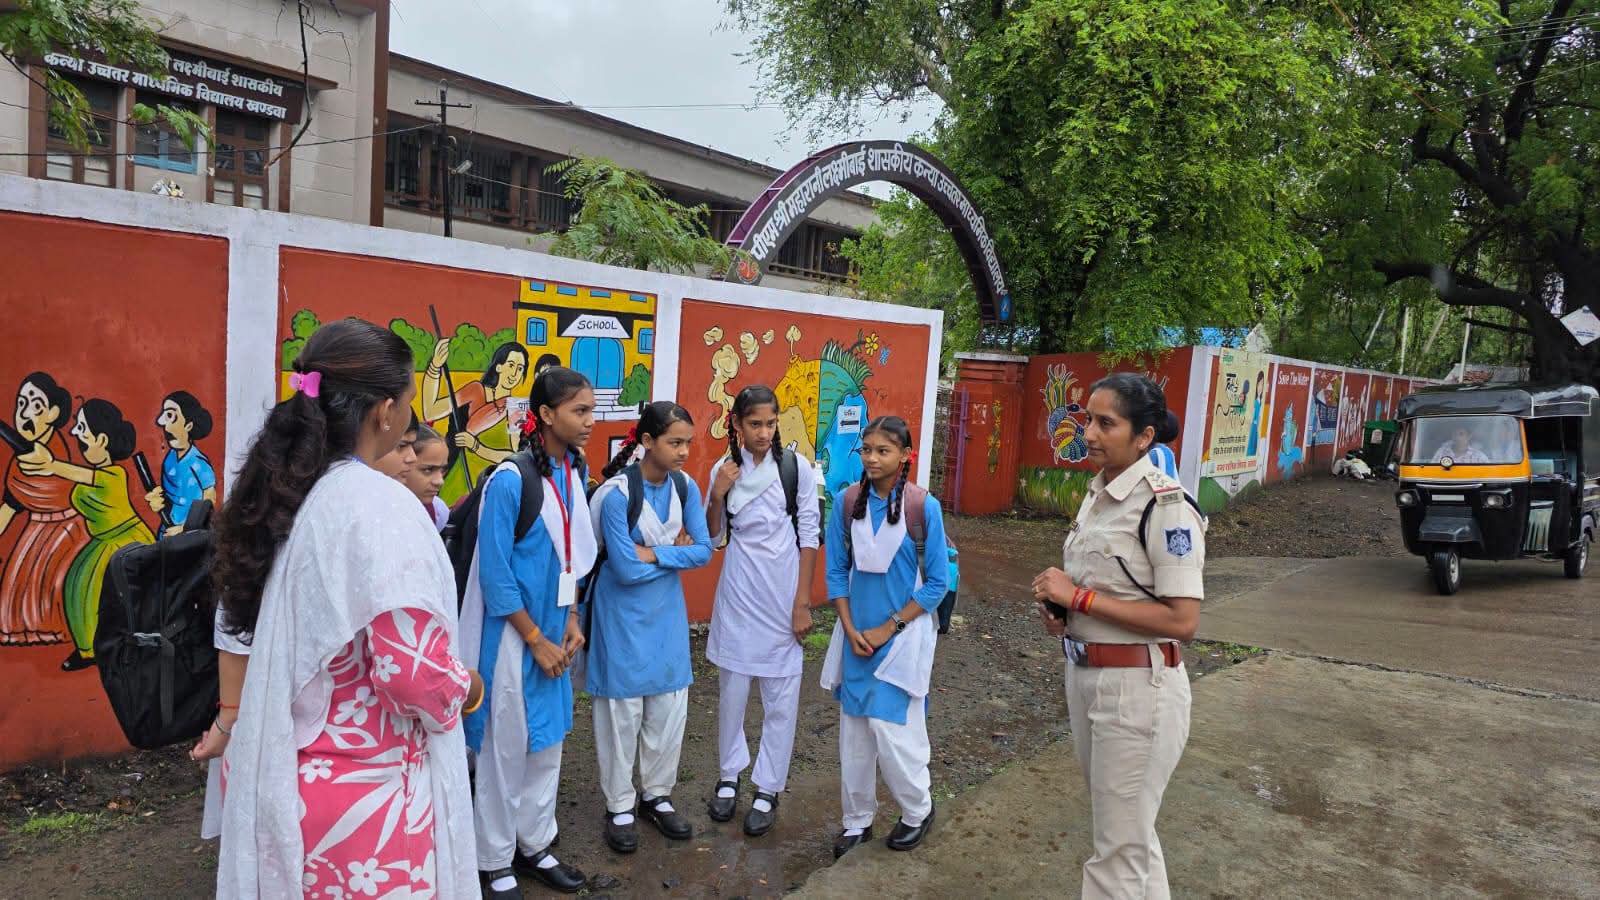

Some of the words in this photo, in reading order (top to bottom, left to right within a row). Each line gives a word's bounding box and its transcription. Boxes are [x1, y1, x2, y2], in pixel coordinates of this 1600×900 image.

[44, 52, 85, 72] कन्या
[87, 60, 130, 82] उच्चतर
[195, 83, 245, 110] विद्यालय
[246, 98, 288, 119] खण्डवा
[230, 74, 283, 97] शासकीय
[867, 143, 914, 175] शासकीय
[914, 155, 940, 188] कन्या
[577, 320, 618, 330] SCHOOL
[1278, 371, 1290, 385] Save
